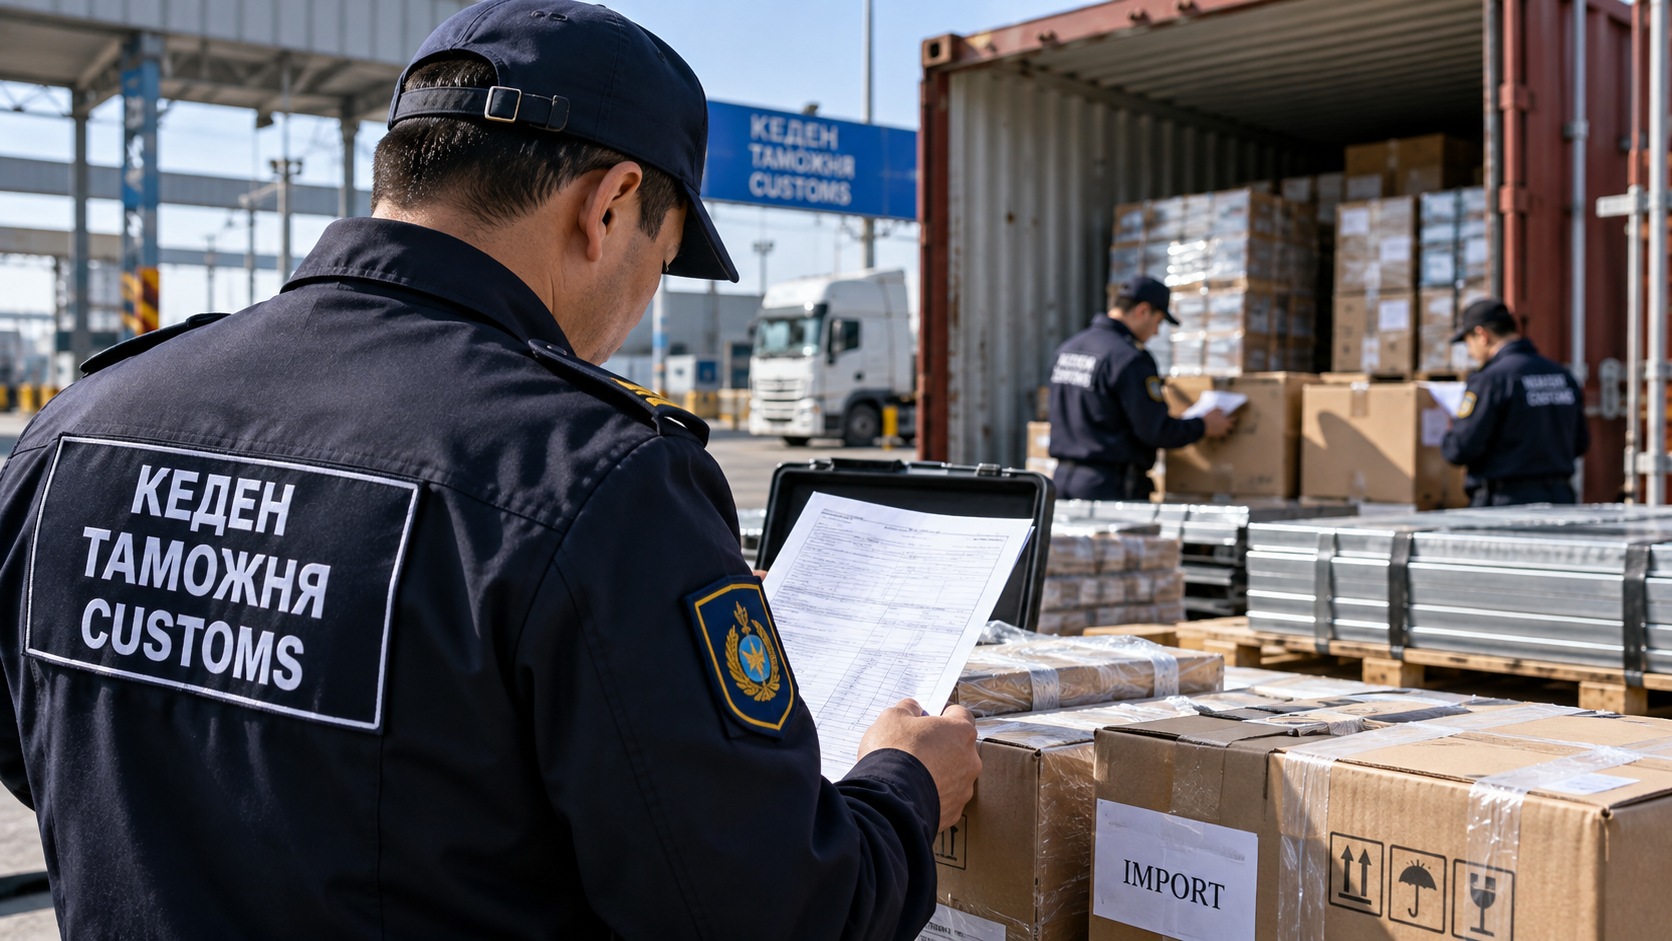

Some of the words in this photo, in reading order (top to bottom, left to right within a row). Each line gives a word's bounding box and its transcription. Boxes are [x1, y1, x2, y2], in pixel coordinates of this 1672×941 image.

[751, 114, 838, 149] КЕДЕН
[748, 143, 855, 179] ТАМОЖНЯ
[749, 172, 851, 206] CUSTOMS
[131, 465, 296, 536] КЕДЕН
[83, 526, 331, 619] ТАМОЖНЯ
[81, 598, 304, 691] CUSTOMS
[1123, 859, 1225, 910] IMPORT
